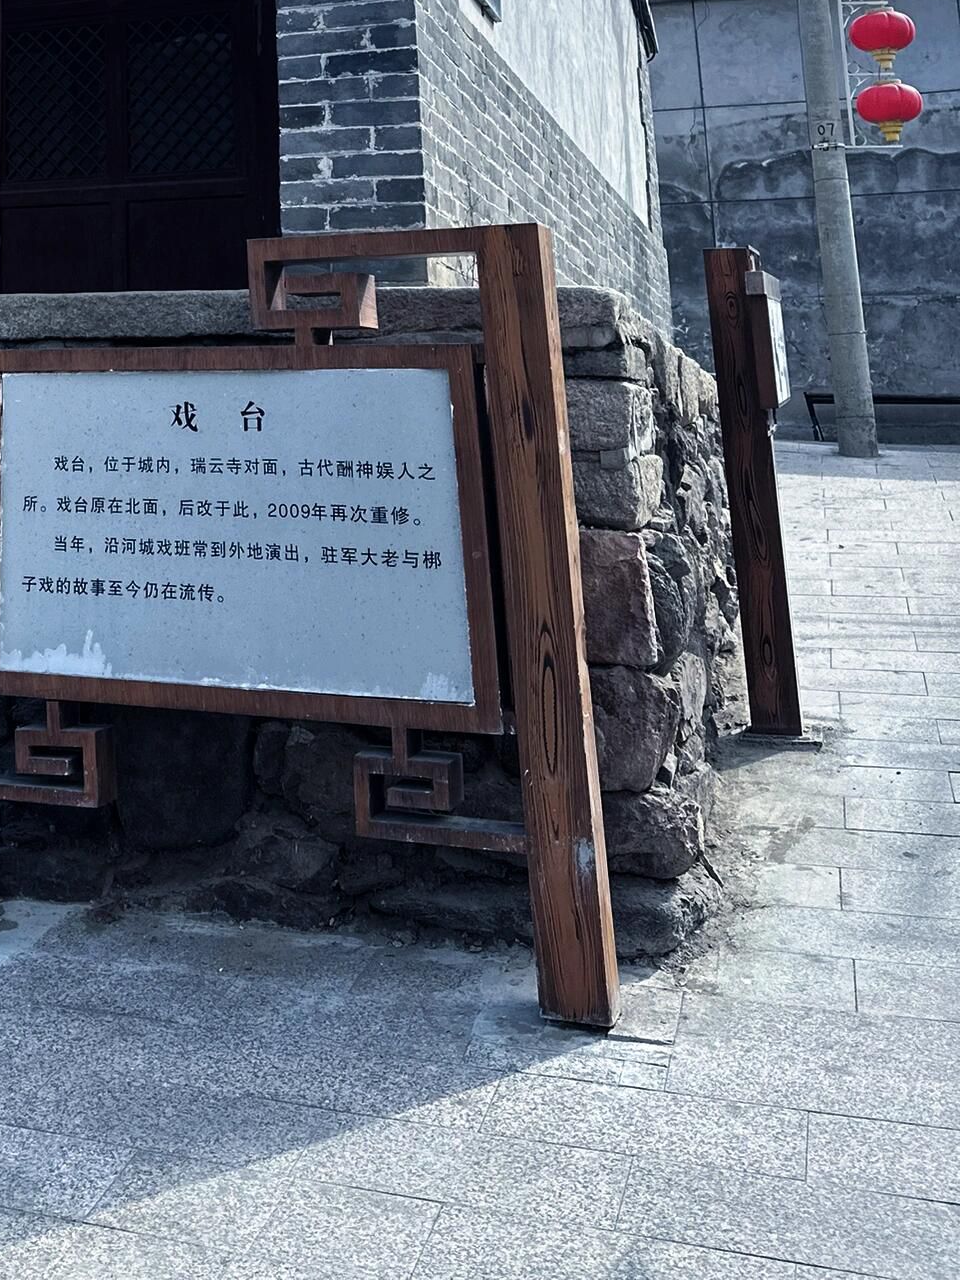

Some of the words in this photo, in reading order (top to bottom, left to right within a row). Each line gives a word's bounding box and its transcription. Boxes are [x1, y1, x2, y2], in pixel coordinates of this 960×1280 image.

[817, 122, 834, 137] 07
[53, 455, 436, 481] 戏台，位于城内，瑞云寺对面，古代酬神娱人之
[22, 495, 422, 527] 所。戏台原在北面，后改于此，2009年再次重修。
[54, 535, 442, 570] 当年，沿河城戏班常到外地演出，驻军大老与梆
[21, 575, 225, 603] 子戏的故事至今仍在流传。
